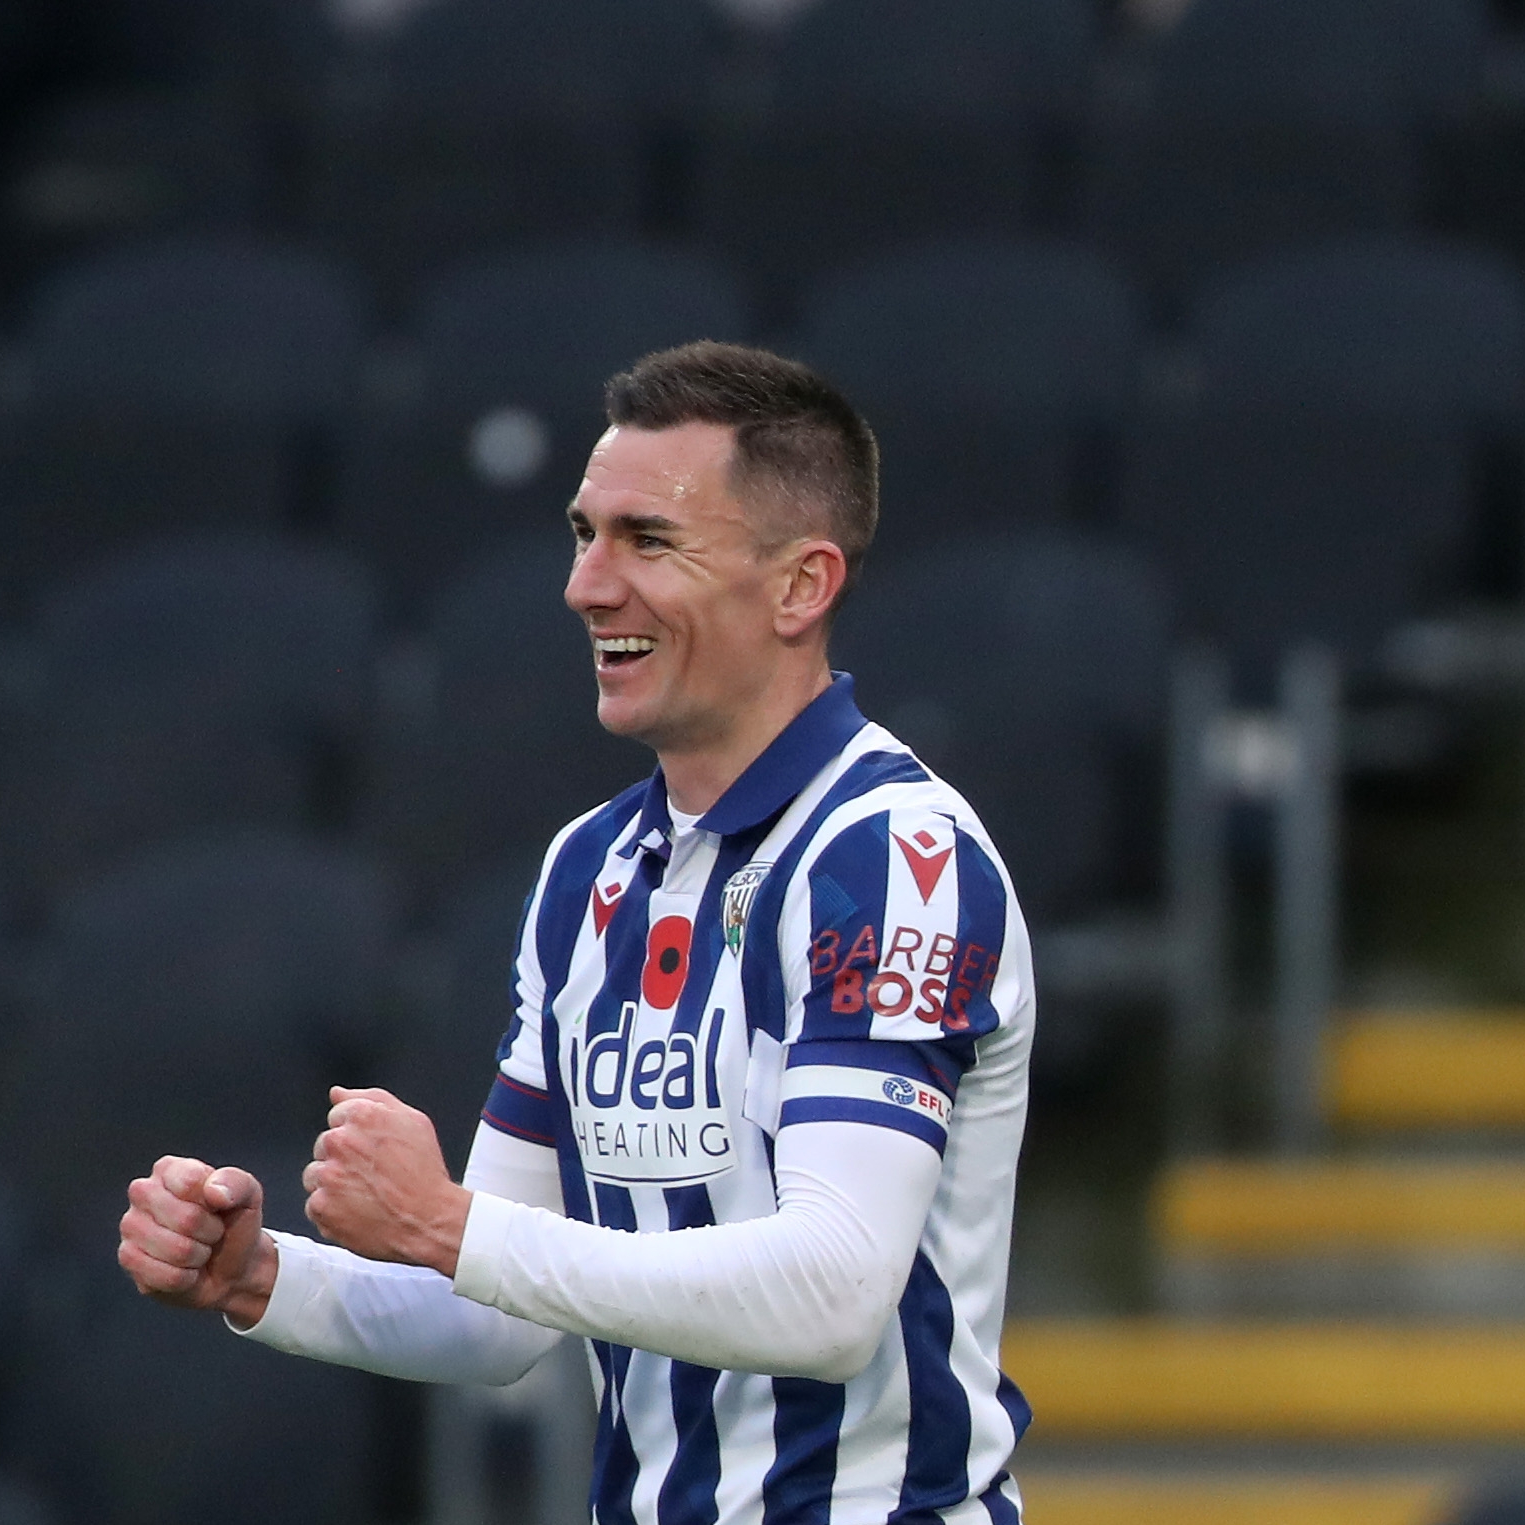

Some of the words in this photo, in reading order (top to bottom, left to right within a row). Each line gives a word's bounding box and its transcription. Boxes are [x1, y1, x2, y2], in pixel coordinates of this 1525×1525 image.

[812, 925, 998, 992] BARBER
[831, 968, 971, 1030] BOSS
[570, 1006, 725, 1110] ideal
[918, 1089, 944, 1118] EFL
[576, 1122, 730, 1158] HEATING
